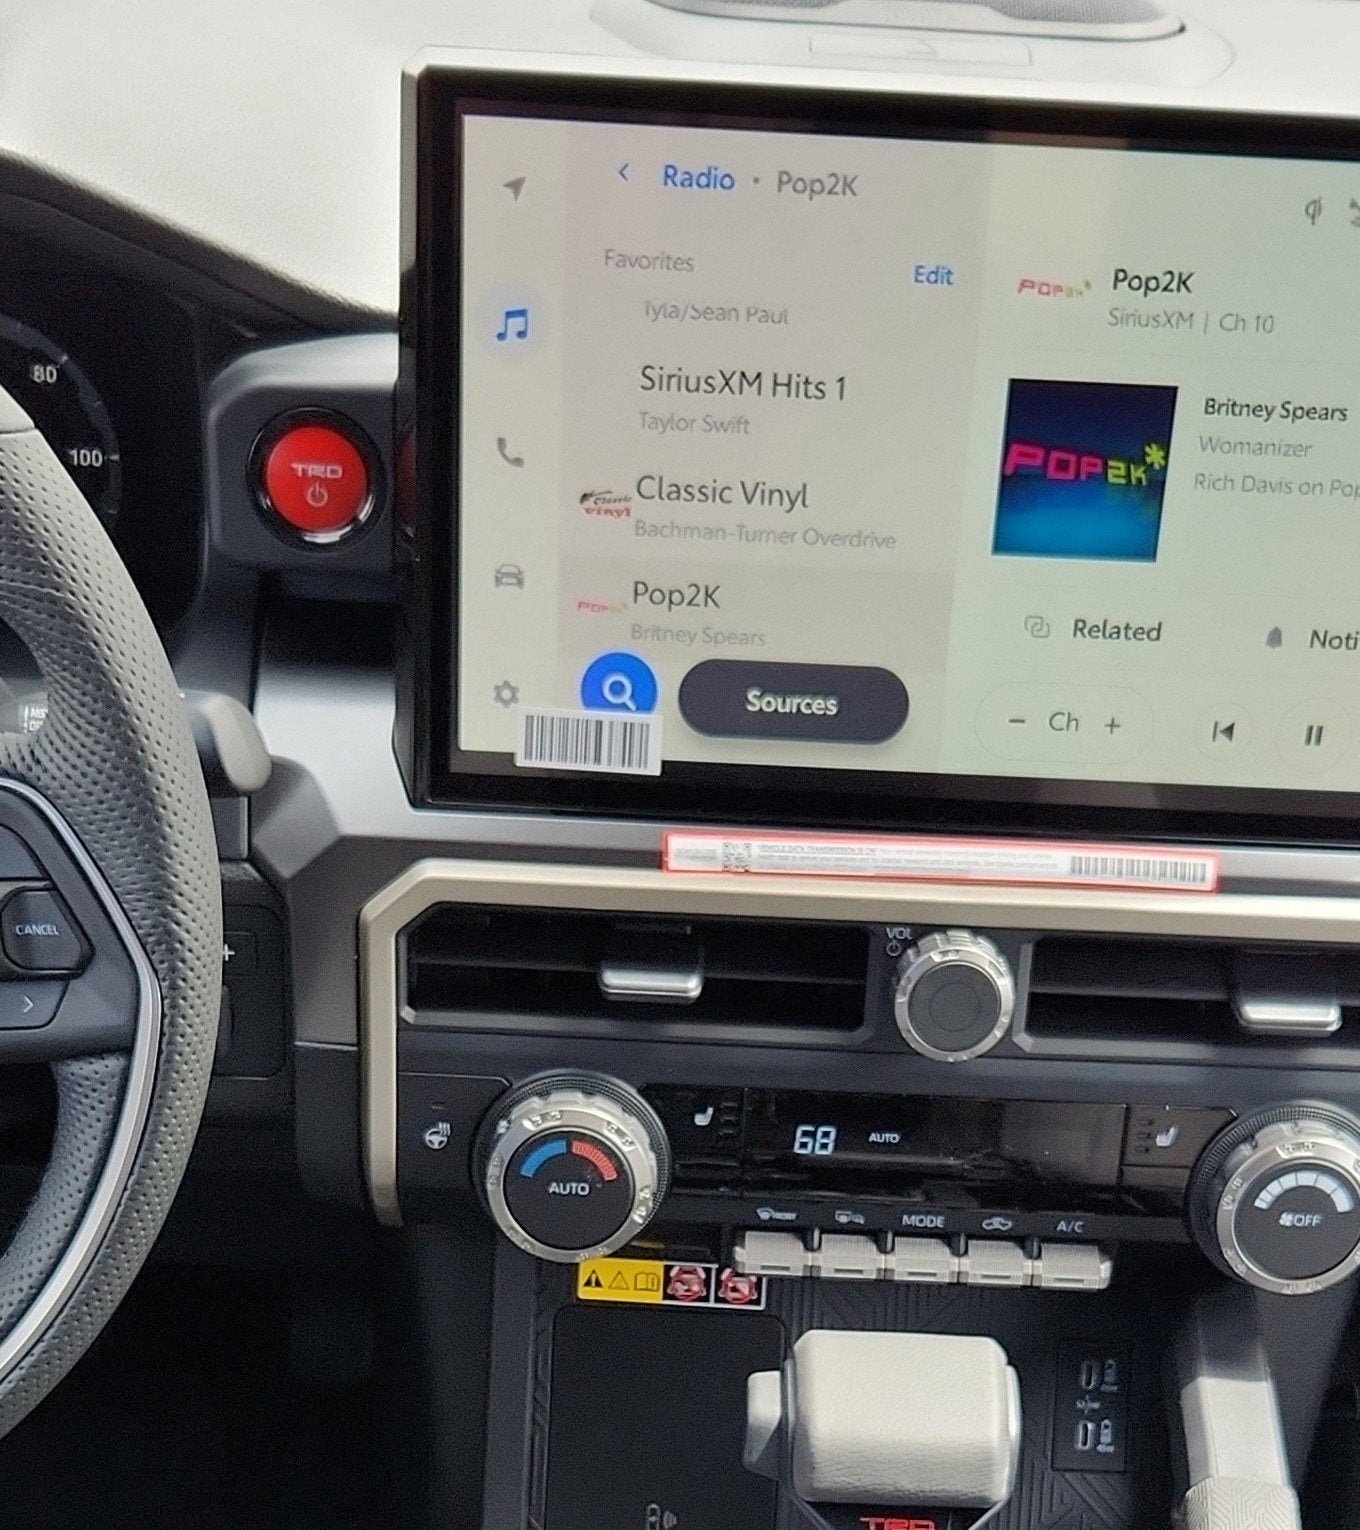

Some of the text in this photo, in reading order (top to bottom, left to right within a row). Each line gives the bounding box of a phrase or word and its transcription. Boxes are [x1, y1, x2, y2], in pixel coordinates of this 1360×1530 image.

[662, 164, 736, 191] Radio
[777, 170, 859, 200] Pop2K
[604, 249, 695, 273] Favorites
[913, 265, 955, 287] Edit
[1113, 268, 1194, 297] Pop2K
[746, 305, 789, 326] Paul
[1108, 307, 1276, 334] SiriusXM Ch 10
[33, 364, 58, 384] 80
[640, 365, 847, 401] SiriusXM Hits 1
[1203, 398, 1349, 423] Britney Spears
[639, 411, 751, 436] Taylor Swift
[69, 448, 103, 468] 100
[1198, 436, 1314, 459] Womanizer
[289, 461, 344, 481] TRD
[636, 475, 809, 514] Classic Vinyl
[1193, 472, 1235, 494] Rich
[1241, 475, 1295, 496] Davis
[1298, 480, 1324, 497] on
[634, 518, 897, 550] Bachman-Turner Overdrive
[633, 580, 721, 611] Pop2K
[631, 622, 766, 649] Britney Spears
[1072, 618, 1163, 643] Related
[745, 686, 839, 717] Sources
[1048, 711, 1080, 734] Ch
[15, 924, 60, 937] CANCEL
[886, 926, 914, 941] VOL
[793, 1124, 837, 1156] 68
[868, 1132, 902, 1145] AUTO
[548, 1181, 590, 1196] AUTO
[902, 1213, 946, 1229] MODE
[1056, 1219, 1084, 1235] A/C
[1293, 1213, 1322, 1228] OFF
